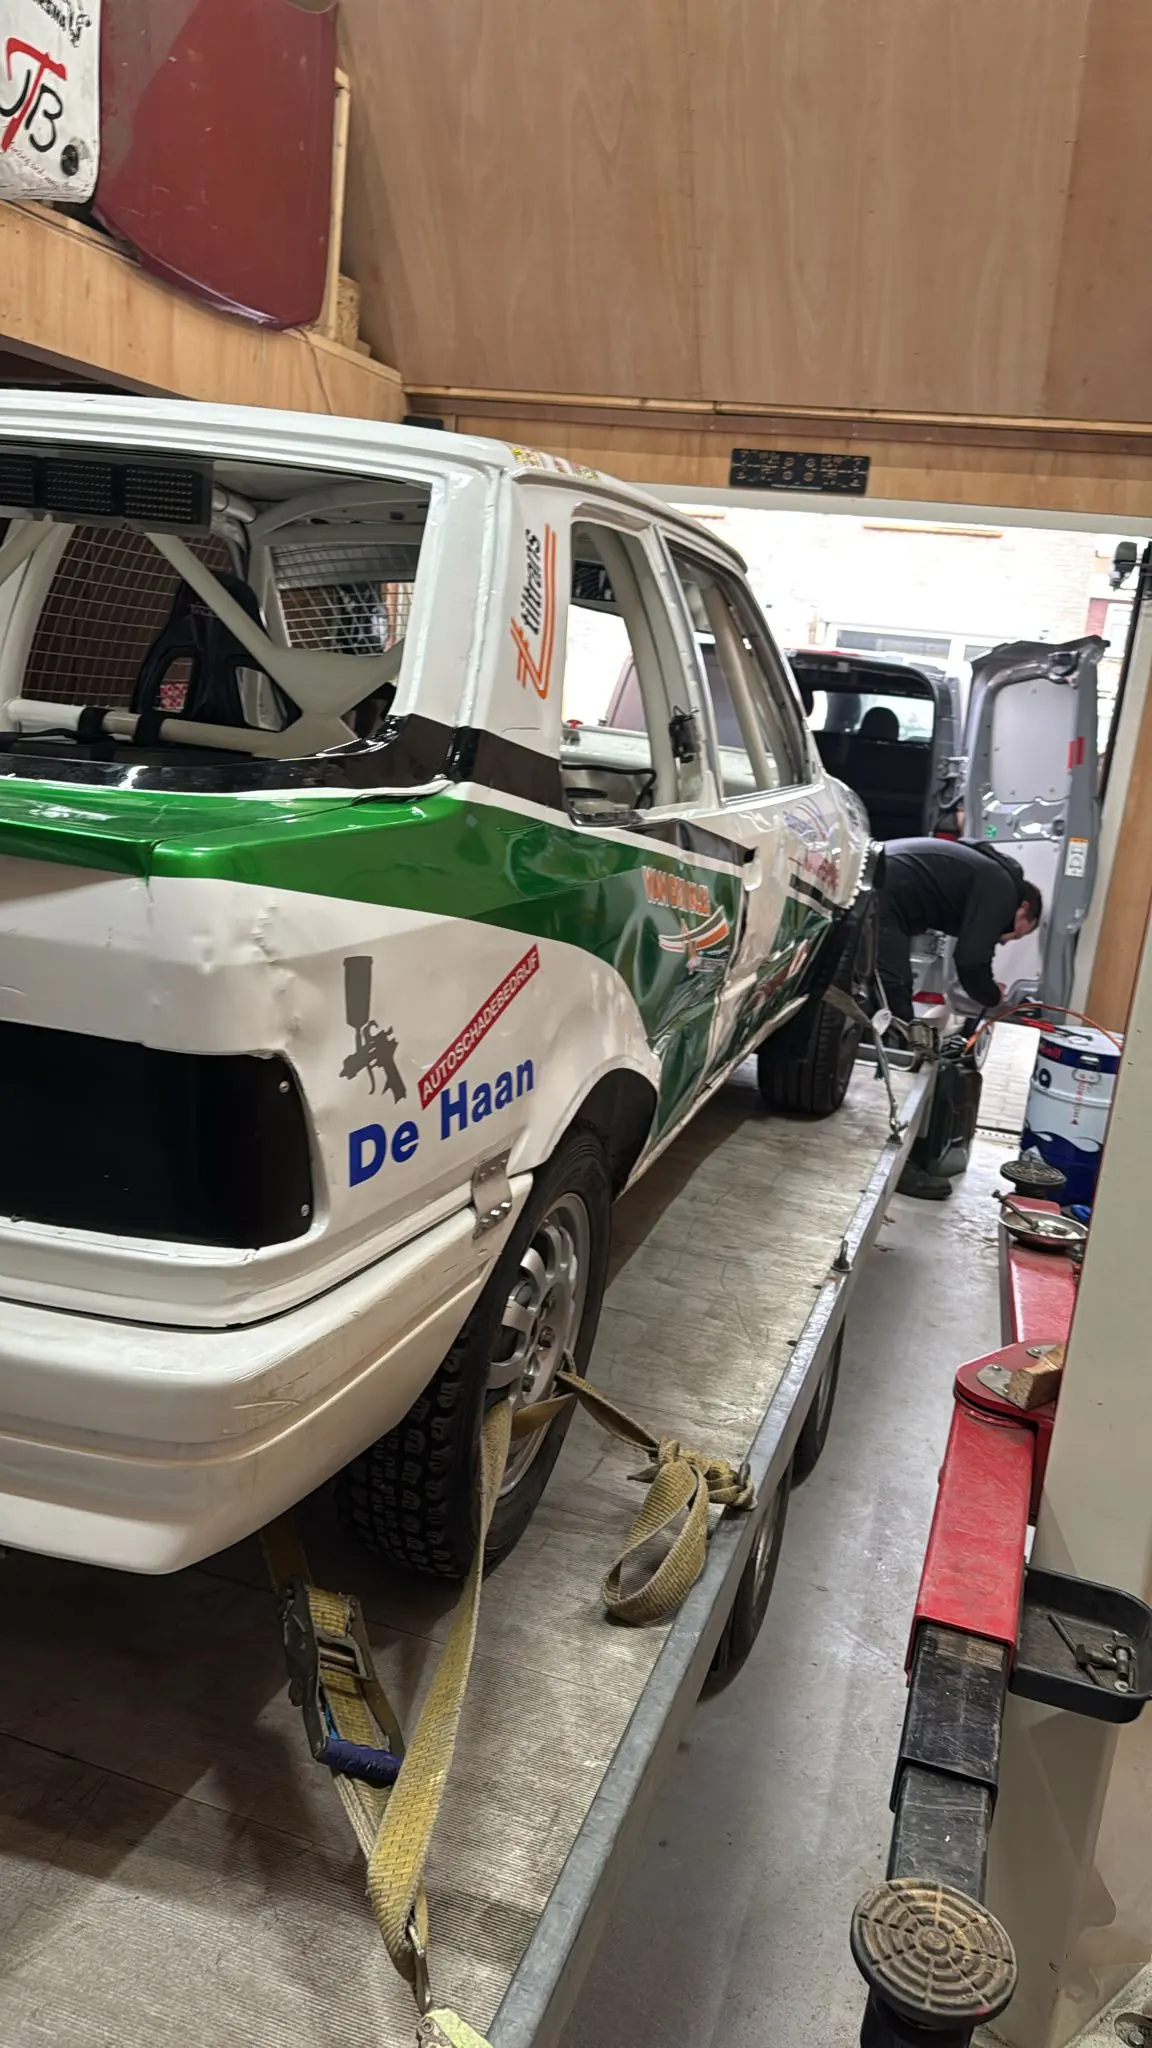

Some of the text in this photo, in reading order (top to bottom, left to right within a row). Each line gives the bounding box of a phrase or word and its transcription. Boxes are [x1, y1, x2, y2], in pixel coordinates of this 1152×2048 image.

[422, 952, 539, 1101] AUTOSCHADEBEDRIJF
[348, 1059, 535, 1188] De Haan
